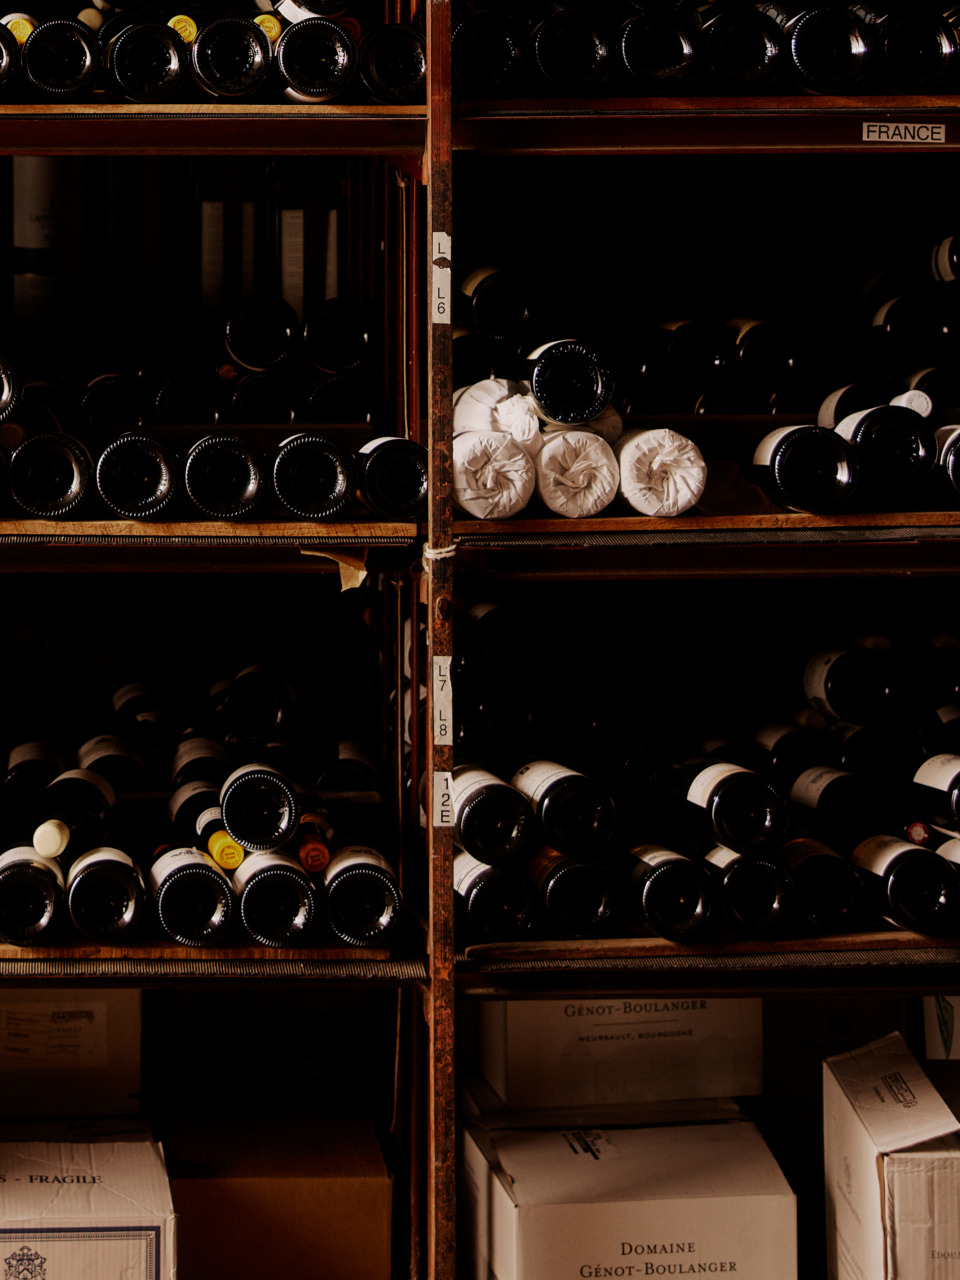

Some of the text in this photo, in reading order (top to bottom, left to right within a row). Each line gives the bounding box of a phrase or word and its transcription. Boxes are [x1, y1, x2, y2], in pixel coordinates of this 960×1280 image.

[866, 124, 942, 141] FRANCE
[438, 665, 448, 737] L7 L8
[440, 777, 451, 824] 12E
[564, 999, 707, 1017] GÉNOT-BOULANGER
[578, 1029, 693, 1042] MEURSAULT, BOURGOGNE
[29, 1174, 103, 1184] FRAGILE
[621, 1242, 696, 1256] DOMAINE
[580, 1261, 738, 1279] GÉNOT-BOULANGER
